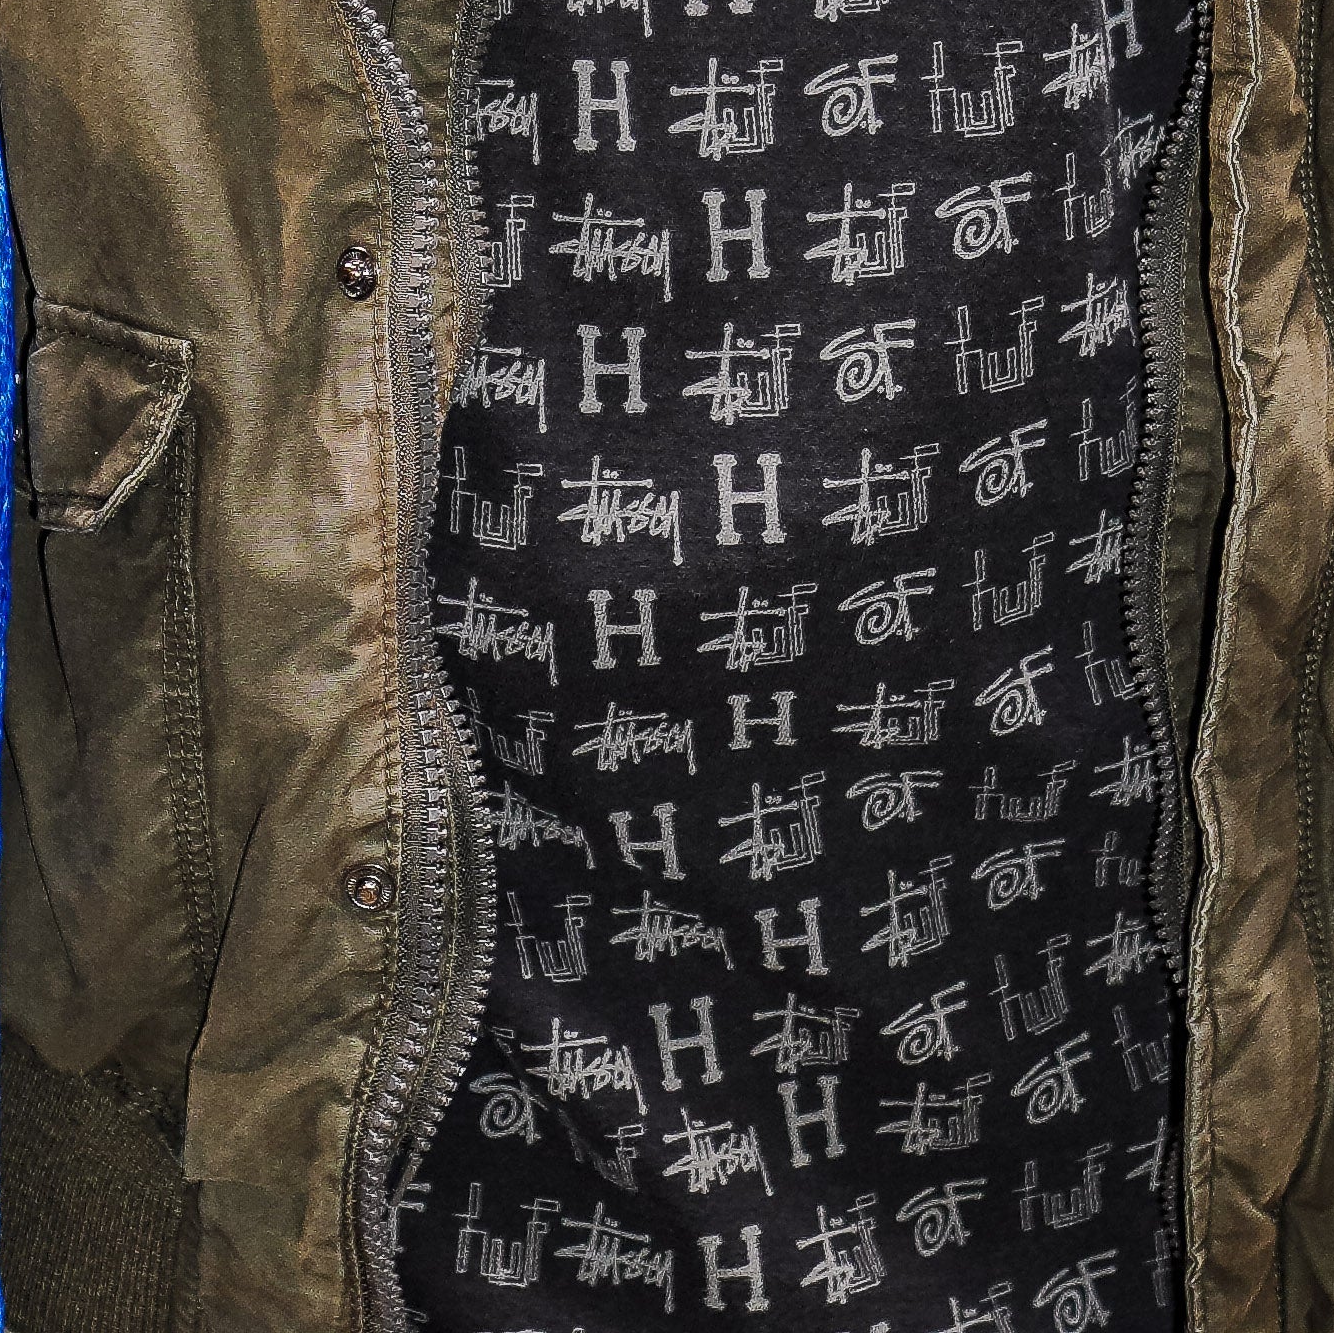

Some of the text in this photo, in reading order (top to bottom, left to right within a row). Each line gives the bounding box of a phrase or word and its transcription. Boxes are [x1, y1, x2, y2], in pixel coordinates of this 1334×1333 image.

[573, 60, 636, 152] H
[704, 189, 770, 281] H
[577, 324, 647, 414] H
[713, 453, 787, 546] H
[587, 589, 662, 670] H
[727, 690, 798, 751] H
[608, 802, 686, 881] H
[754, 897, 830, 976] H
[649, 995, 723, 1091] H
[778, 1076, 847, 1167] H
[698, 1225, 768, 1312] H
